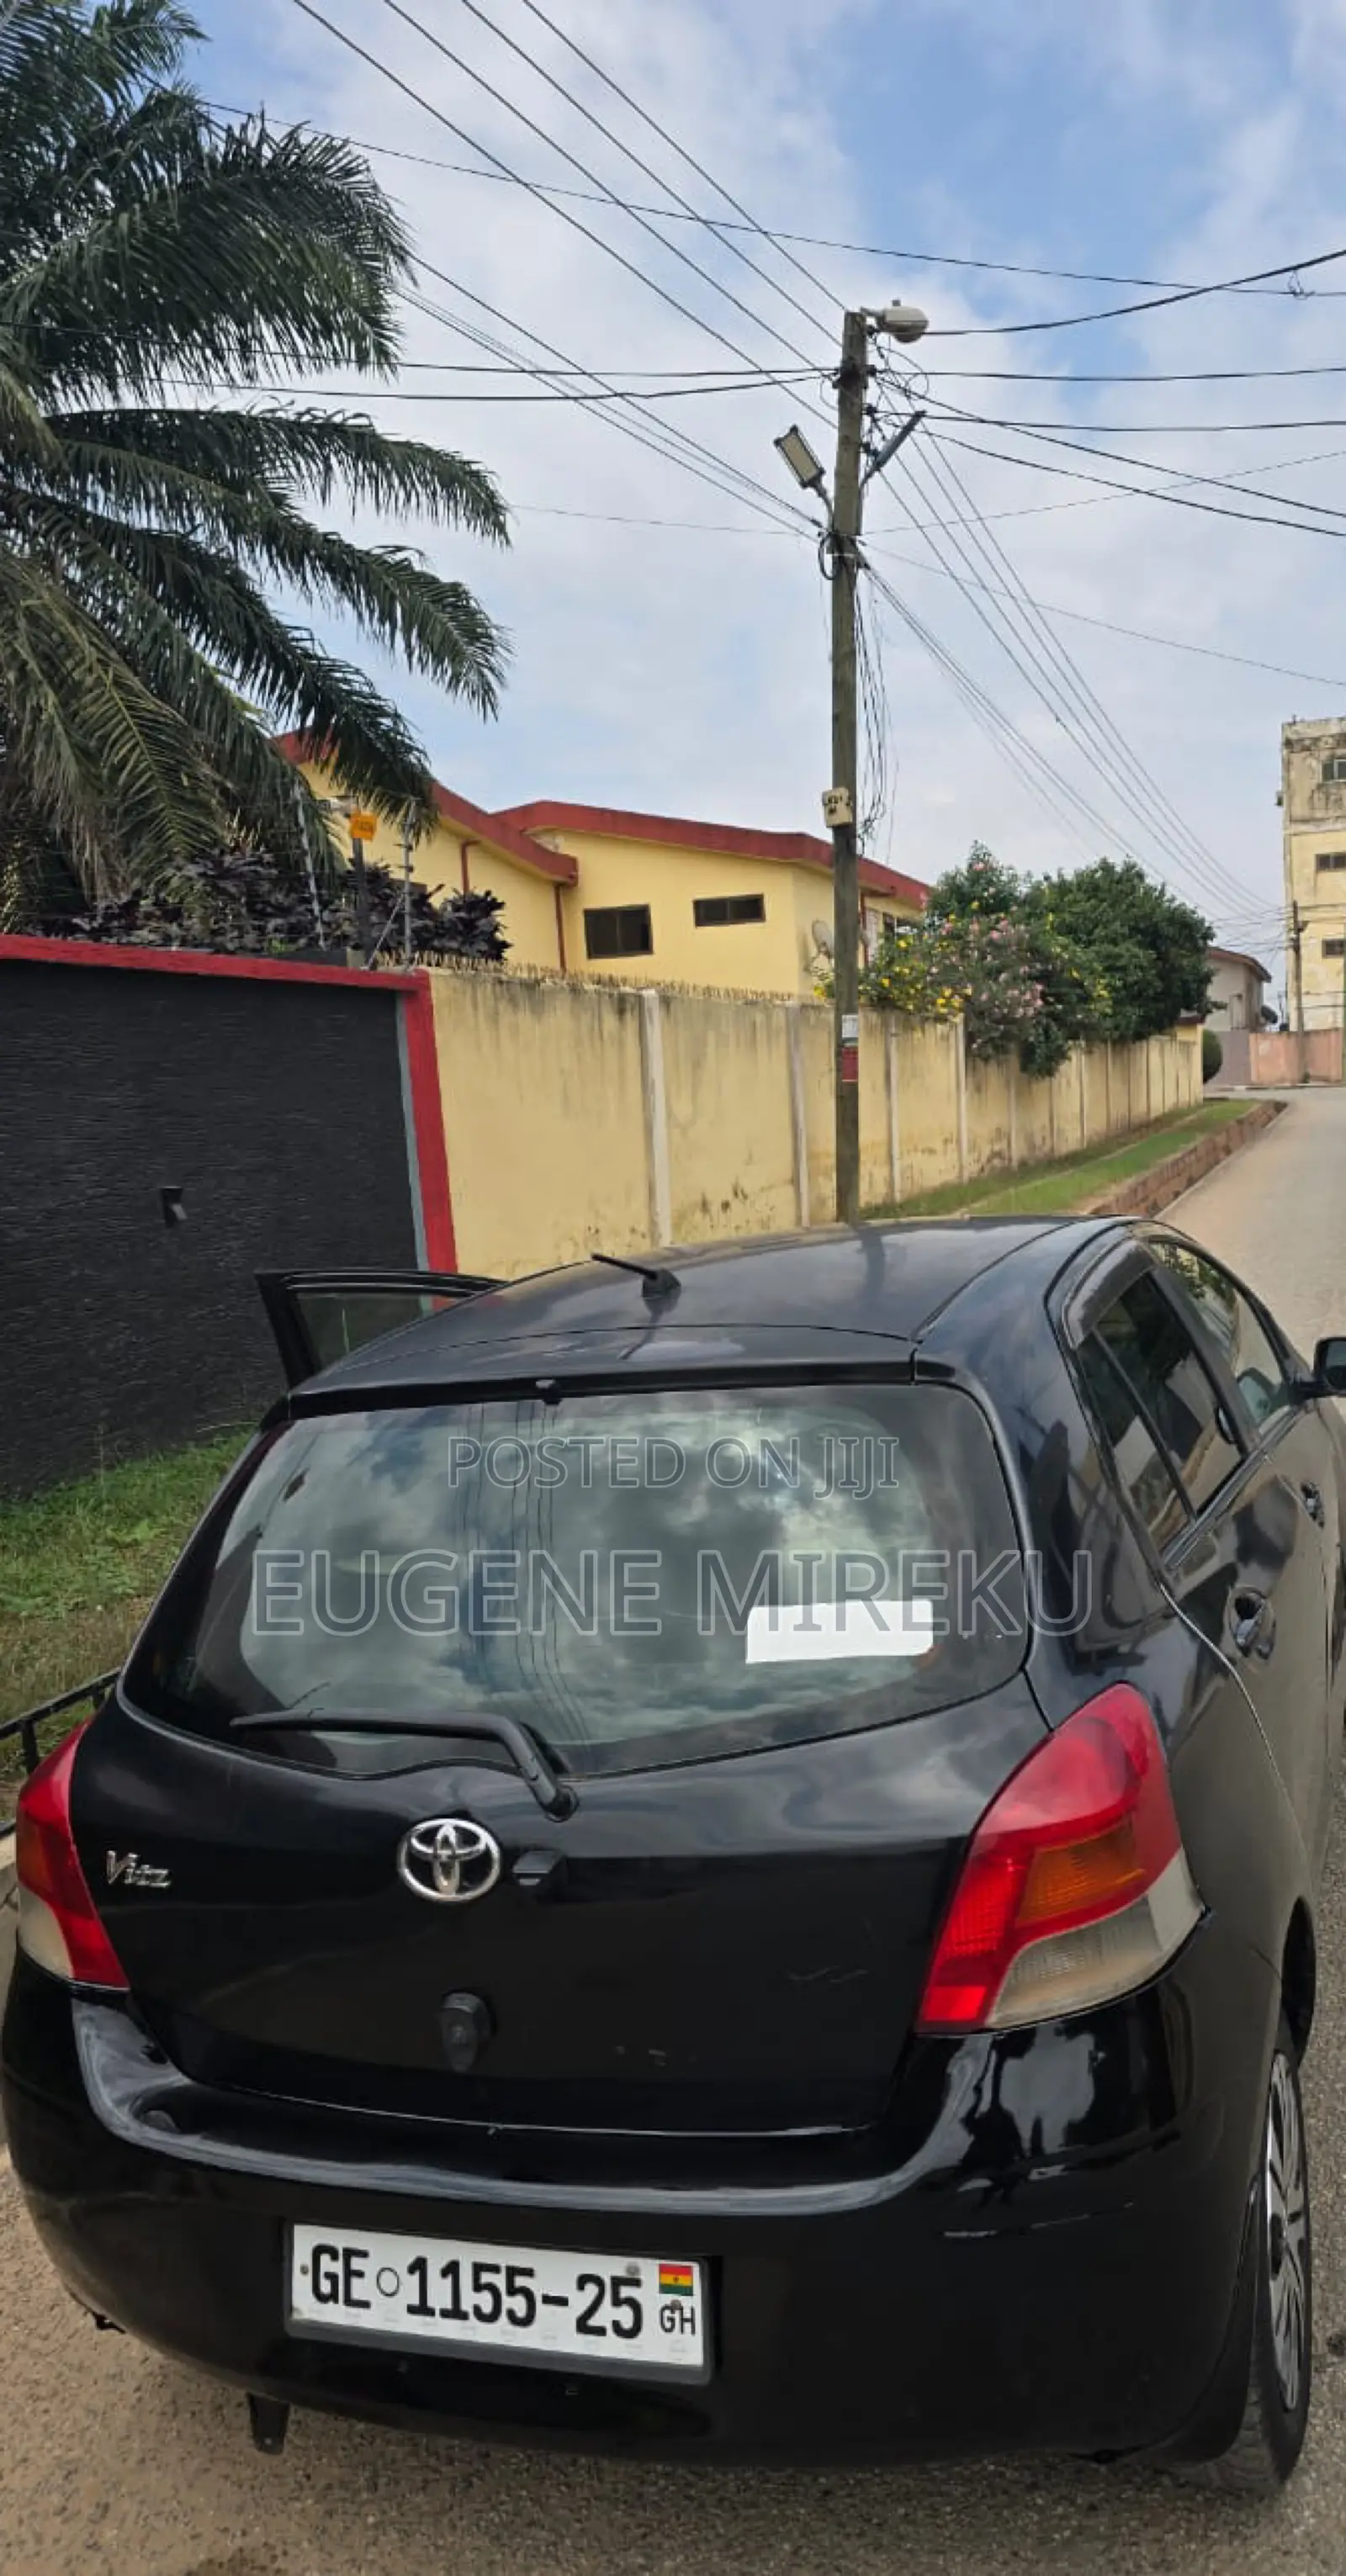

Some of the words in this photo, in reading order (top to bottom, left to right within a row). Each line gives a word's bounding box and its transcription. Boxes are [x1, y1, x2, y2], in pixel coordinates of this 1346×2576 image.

[106, 1850, 171, 1887] Vitz
[310, 2244, 372, 2309] GE
[406, 2256, 644, 2340] 1155-25
[659, 2304, 696, 2335] GH
